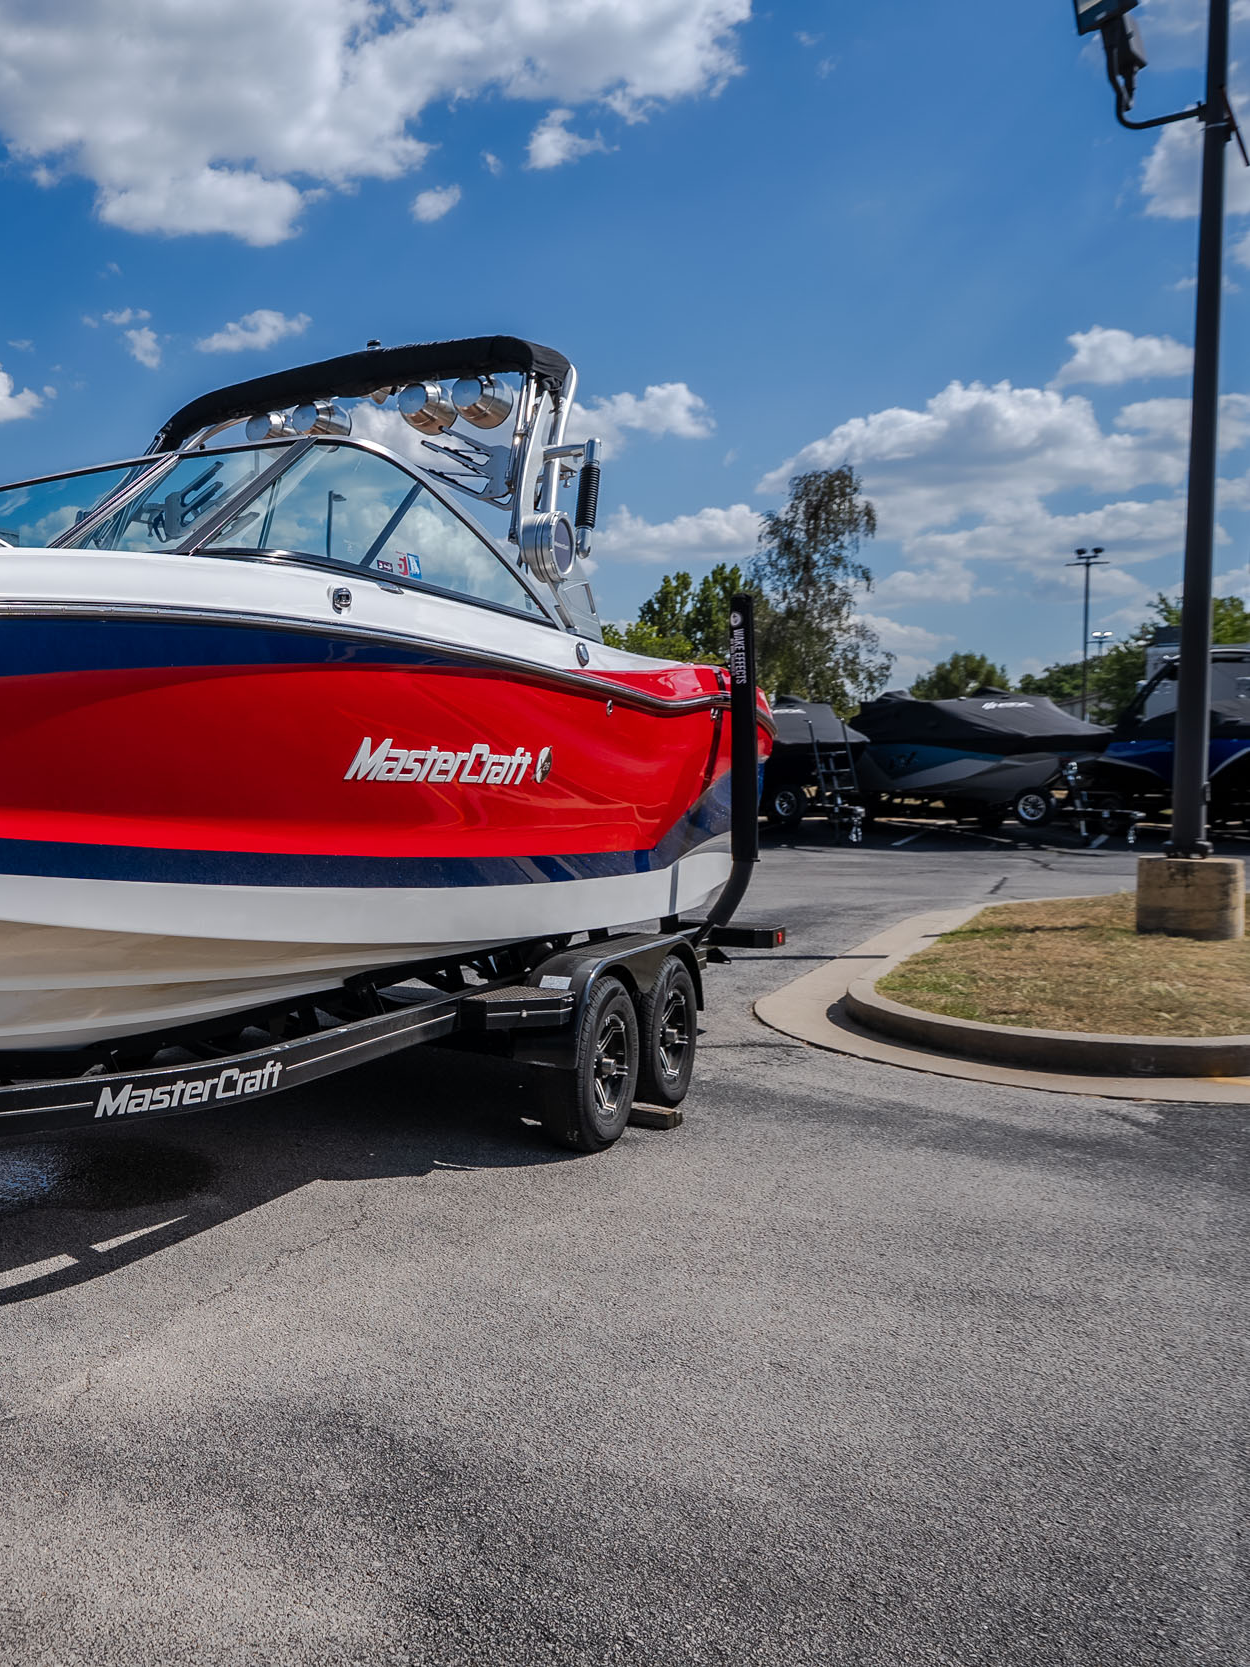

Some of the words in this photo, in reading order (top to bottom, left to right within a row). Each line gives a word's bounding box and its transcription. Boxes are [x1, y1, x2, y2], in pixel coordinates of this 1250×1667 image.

[733, 628, 745, 651] WAKE
[735, 652, 747, 684] EFFECTS
[342, 736, 532, 785] MasterCraft
[94, 1060, 283, 1118] MasterCraft
